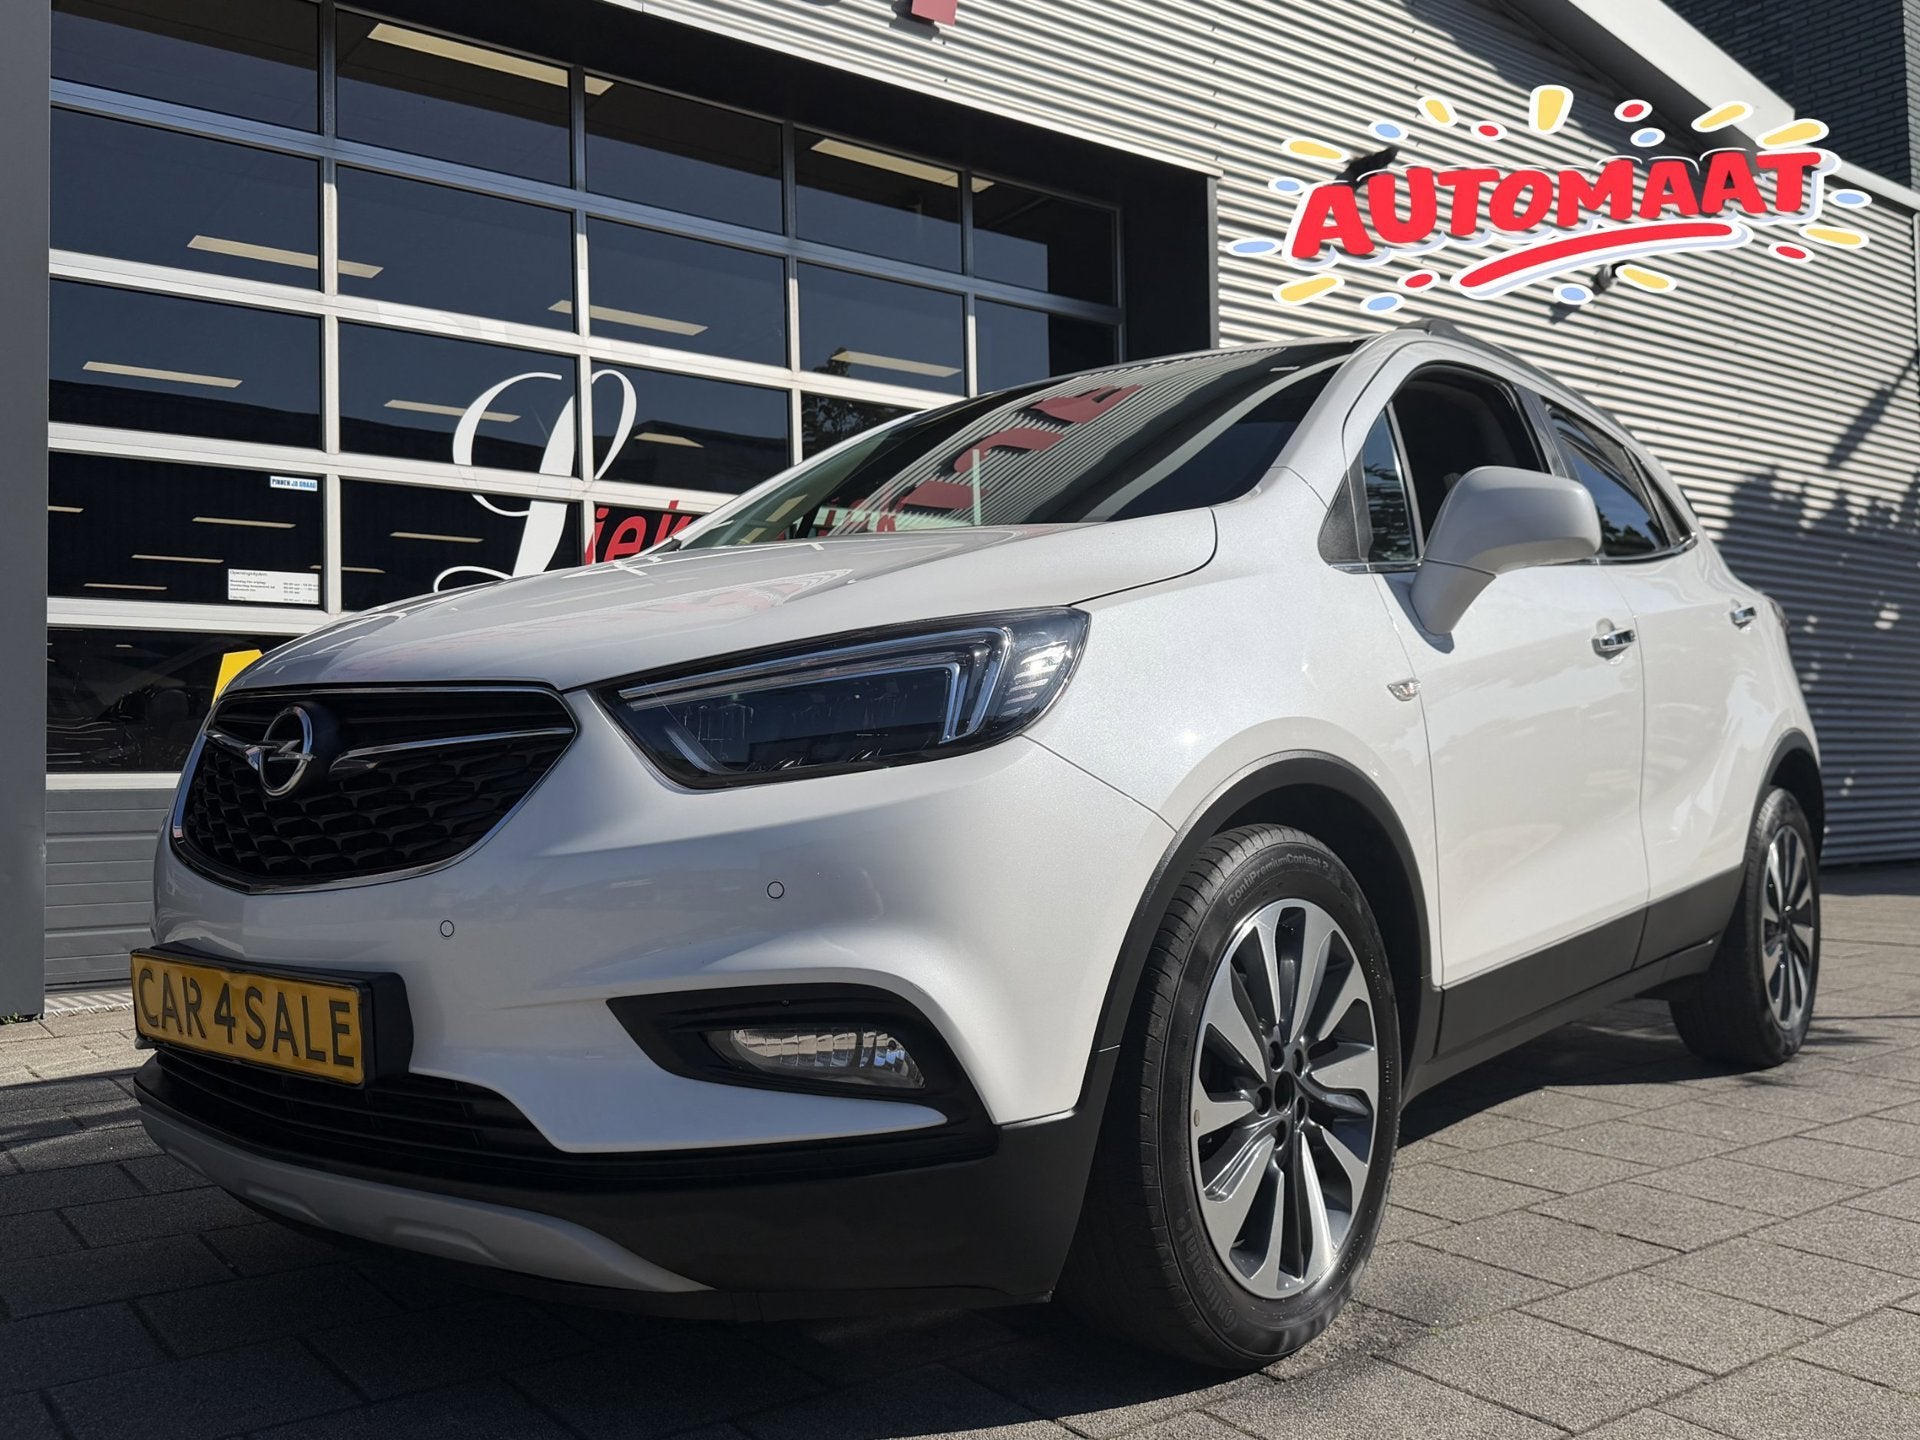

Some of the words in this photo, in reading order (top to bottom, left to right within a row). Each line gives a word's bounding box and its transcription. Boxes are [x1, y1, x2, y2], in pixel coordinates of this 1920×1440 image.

[1227, 853, 1322, 907] ContiPremiumContact
[138, 968, 207, 1039] CAR
[214, 982, 236, 1045] 4
[245, 985, 355, 1067] SALE
